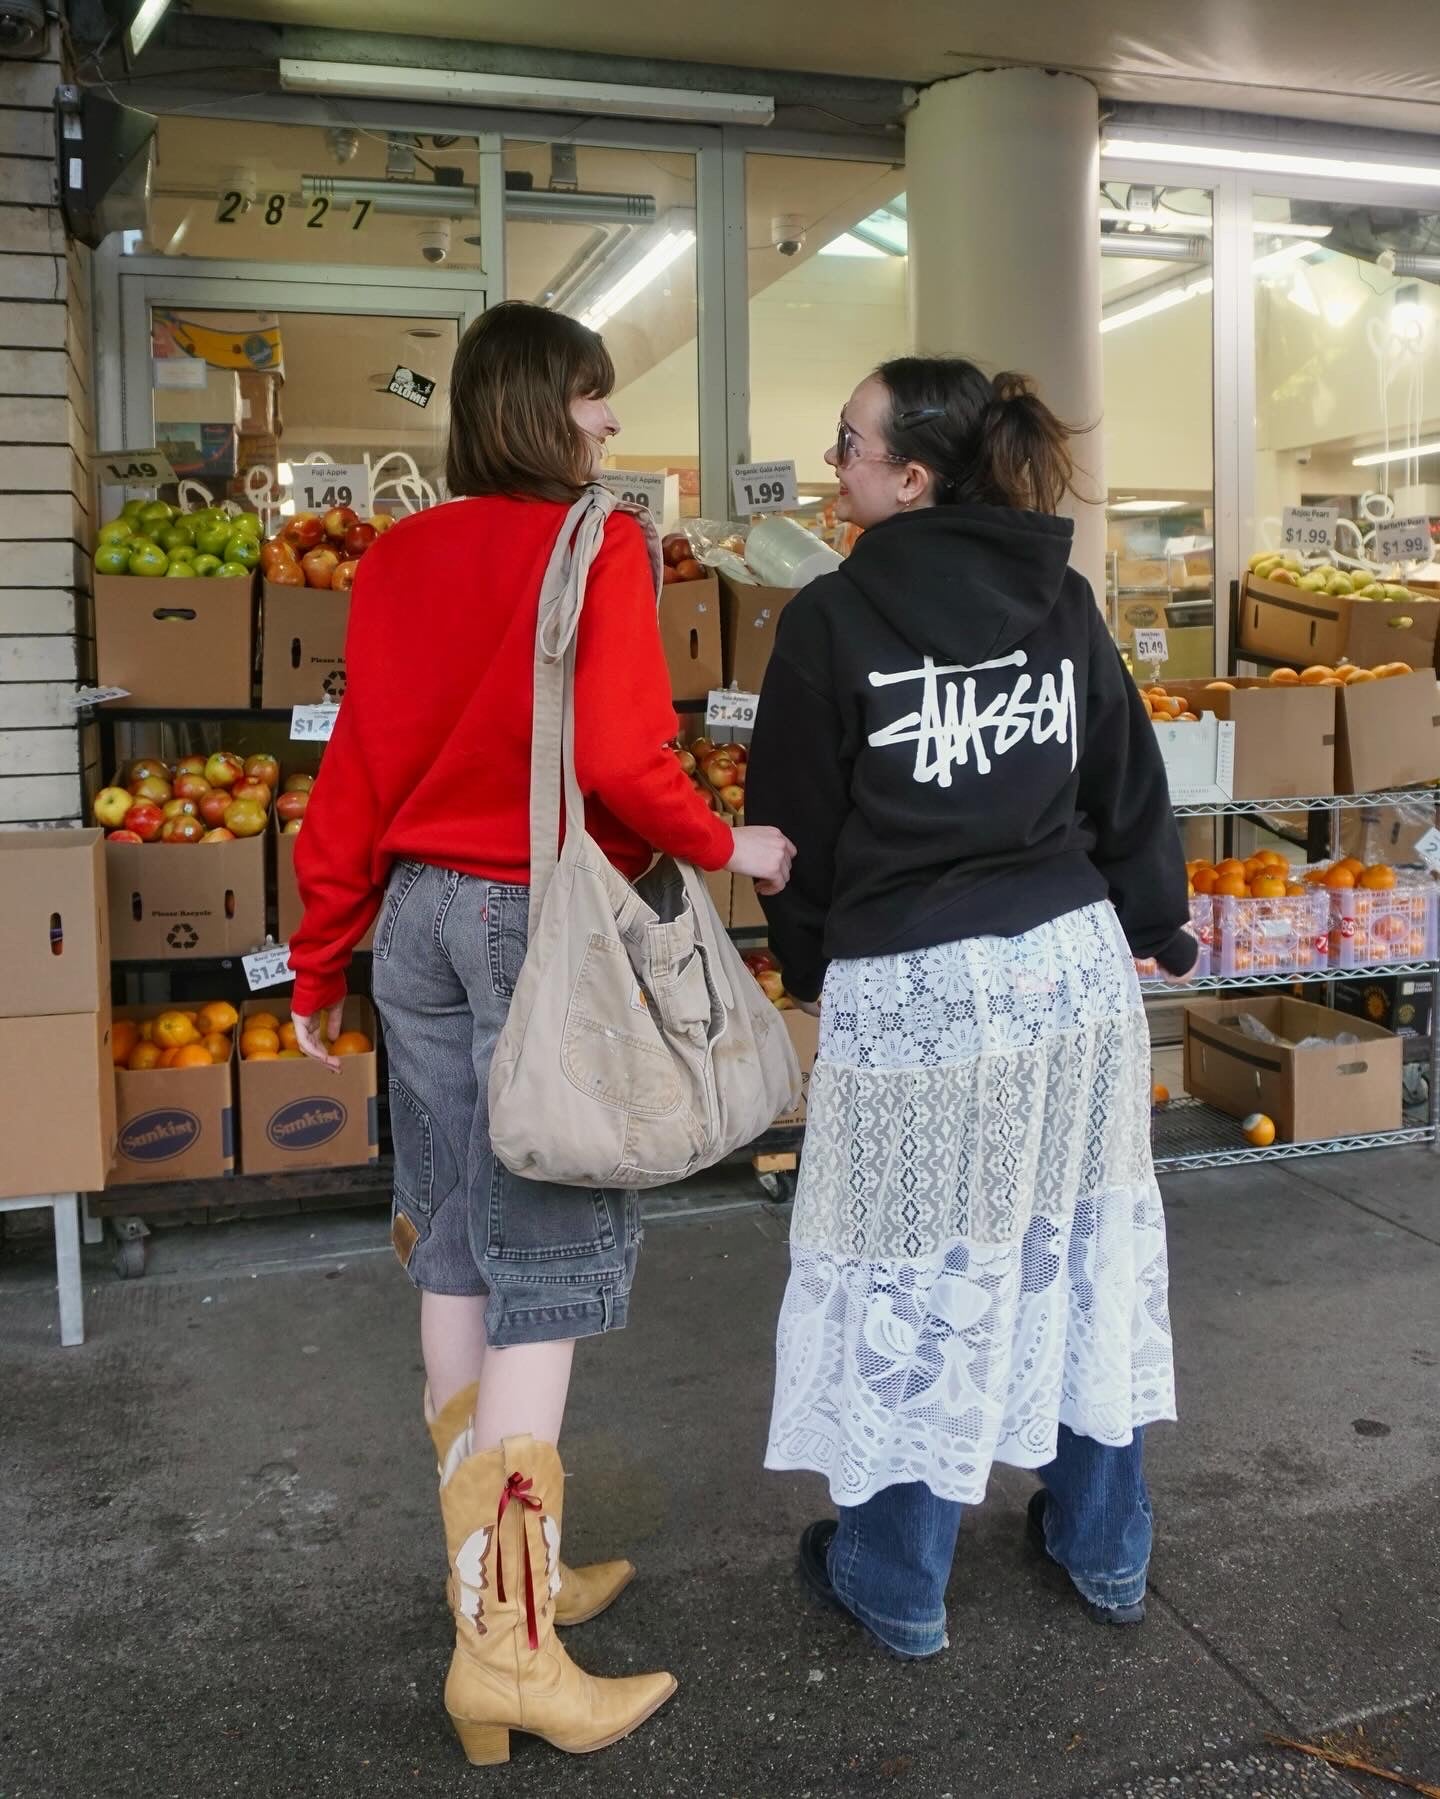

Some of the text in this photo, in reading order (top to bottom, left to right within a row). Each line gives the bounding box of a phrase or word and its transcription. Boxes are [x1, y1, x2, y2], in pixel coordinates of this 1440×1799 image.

[218, 191, 371, 230] 2827
[106, 463, 158, 479] 1.49
[311, 469, 324, 477] Fuji
[625, 475, 640, 483] Fuji
[304, 486, 352, 508] 1.49
[743, 481, 785, 505] 1.99
[1286, 527, 1327, 544] $1.99
[1382, 537, 1423, 556] $1.99
[1138, 641, 1163, 656] $1.49
[709, 704, 754, 721] $1.49
[294, 718, 336, 735] $1.4
[273, 1109, 339, 1140] Sunkist
[124, 1120, 194, 1150] Sunkist
